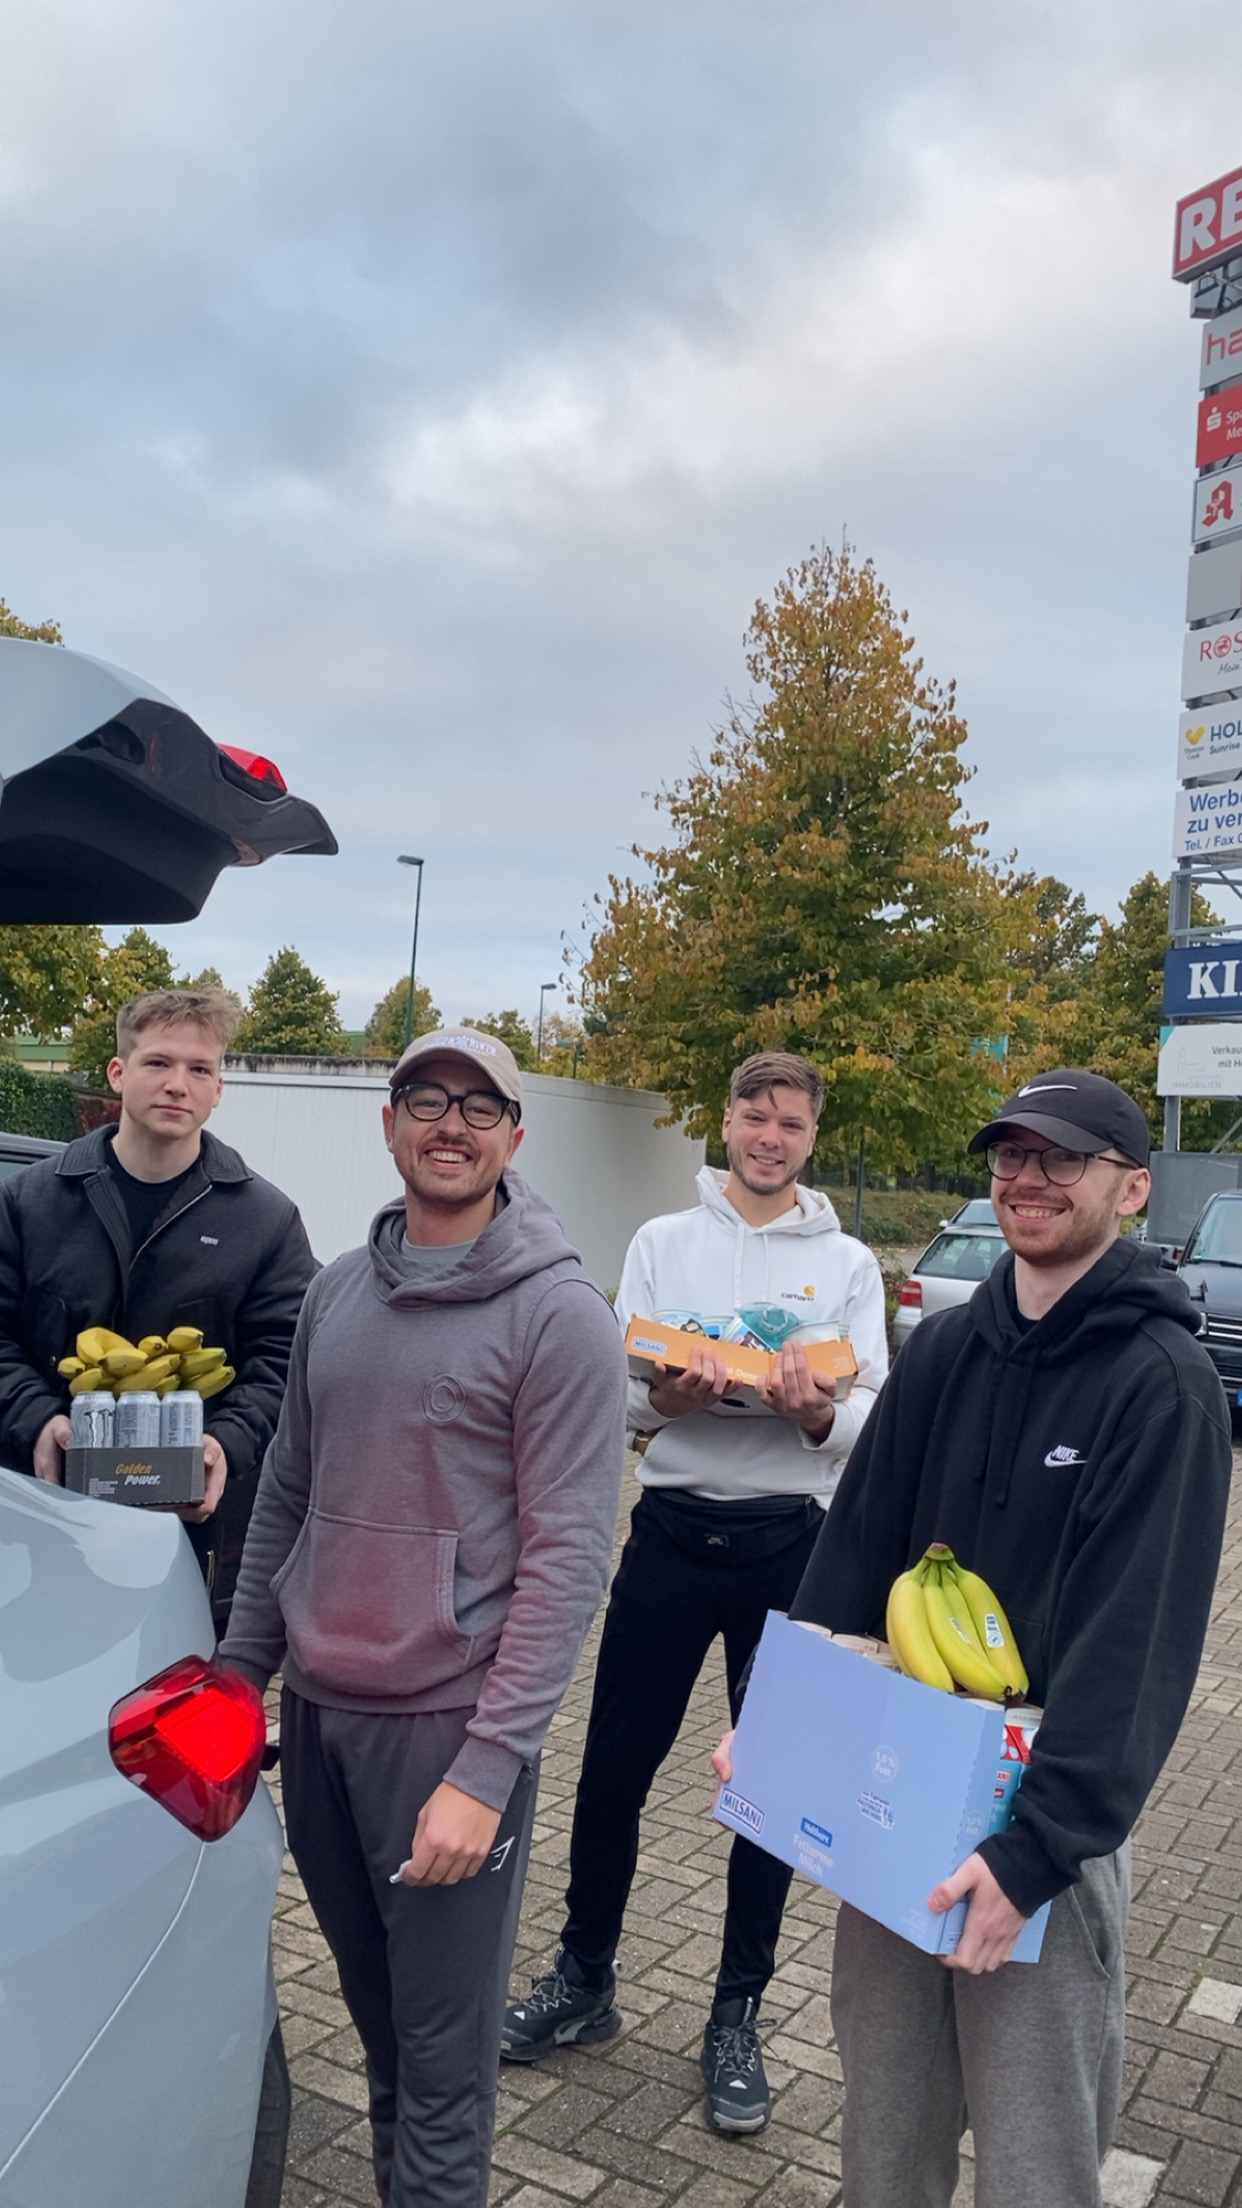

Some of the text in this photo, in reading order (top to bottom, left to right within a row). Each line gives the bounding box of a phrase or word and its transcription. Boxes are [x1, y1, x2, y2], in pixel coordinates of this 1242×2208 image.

[1180, 178, 1242, 261] RE
[1226, 409, 1242, 425] Sp
[1210, 741, 1241, 755] Sunrise
[1190, 789, 1242, 812] Werb
[1187, 818, 1209, 834] zu
[1185, 839, 1203, 851] Tel.
[1214, 835, 1235, 847] Fax
[1187, 960, 1242, 999] KI
[1051, 1445, 1080, 1461] NIKE
[115, 1463, 152, 1475] Golden
[723, 1793, 761, 1828] MILSANI
